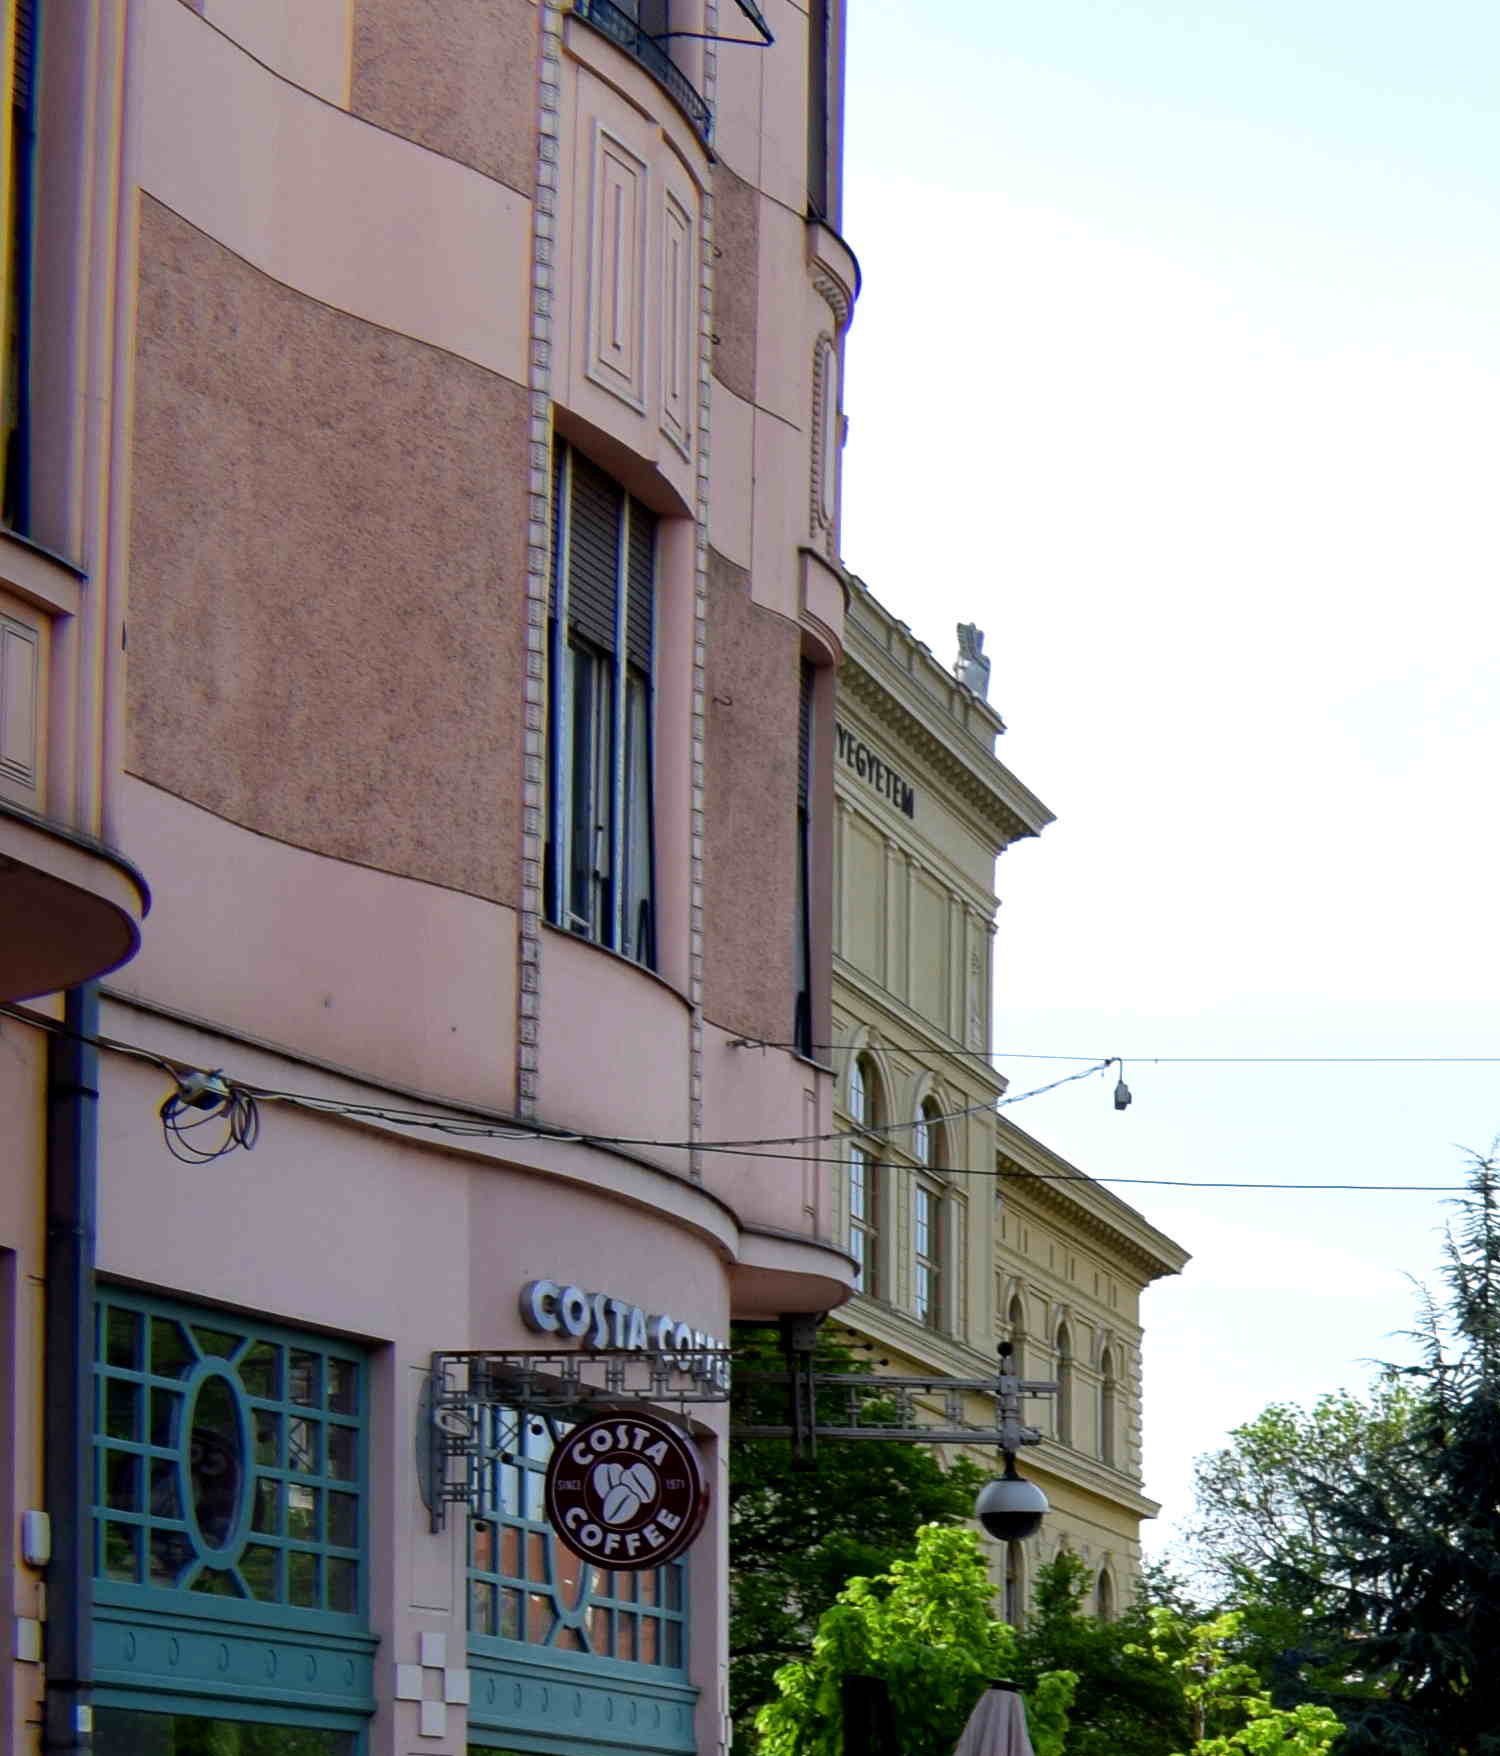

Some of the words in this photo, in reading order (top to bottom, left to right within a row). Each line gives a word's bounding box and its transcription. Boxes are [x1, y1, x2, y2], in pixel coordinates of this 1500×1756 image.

[520, 1279, 649, 1352] COSTA
[572, 1424, 669, 1466] COSTA
[565, 1506, 681, 1556] COFFEE
